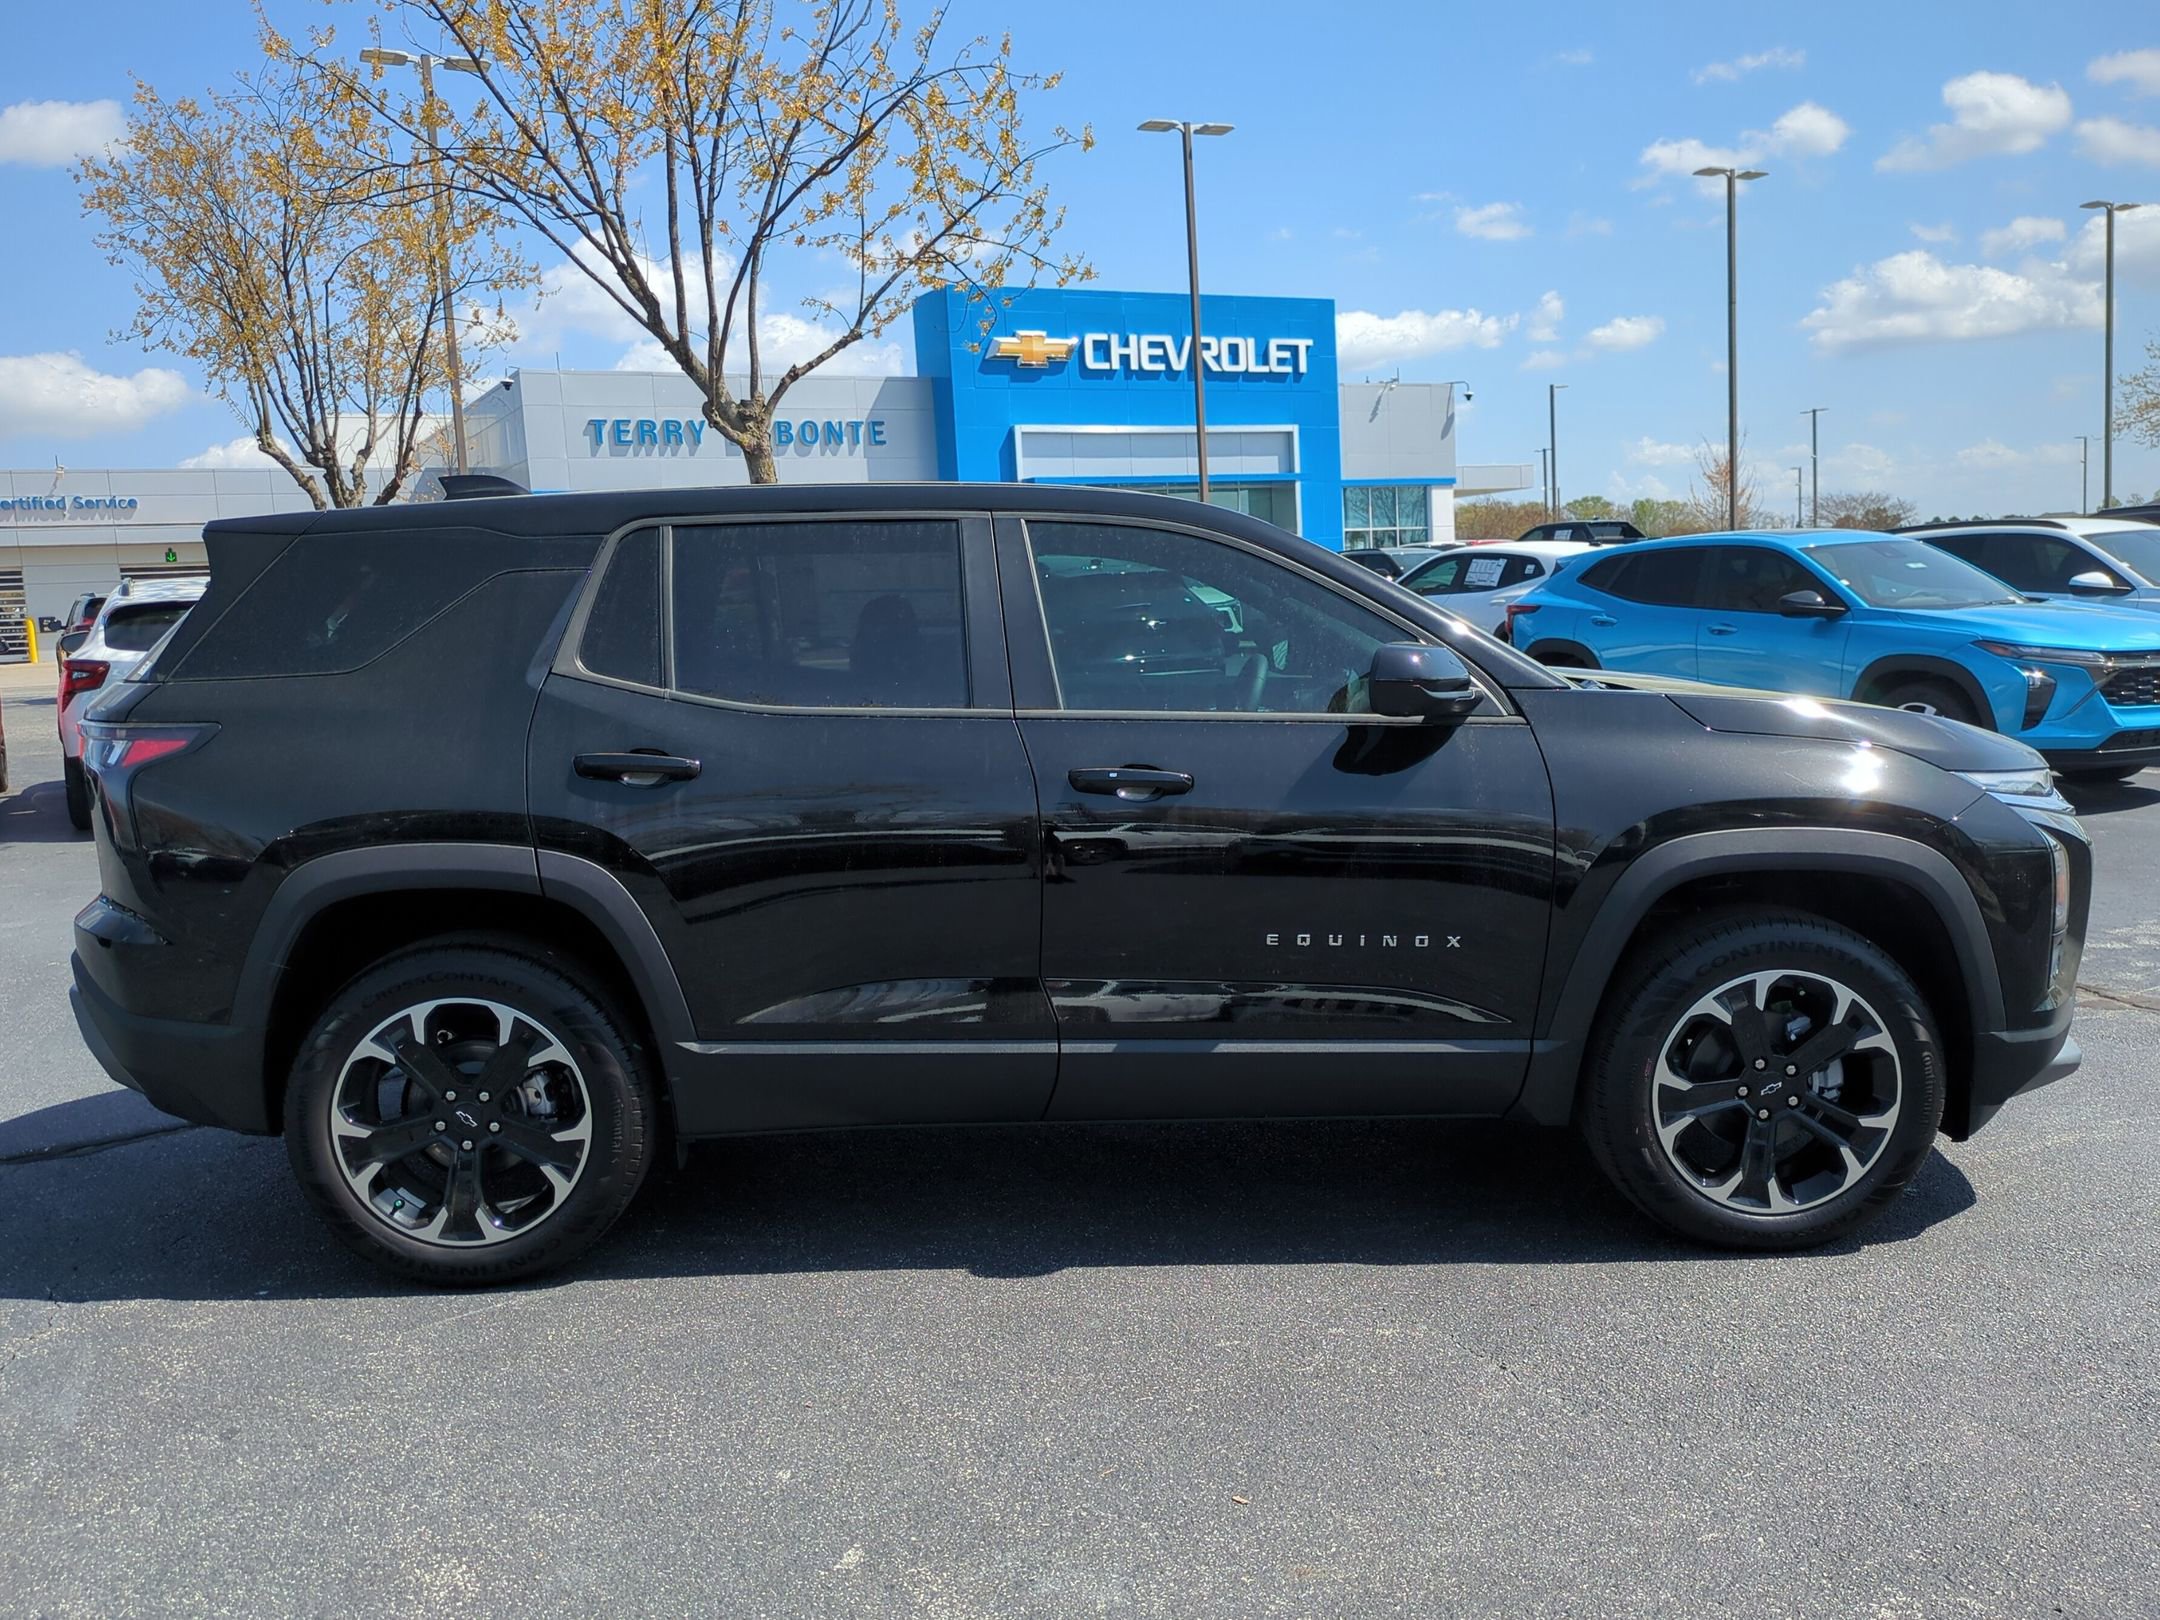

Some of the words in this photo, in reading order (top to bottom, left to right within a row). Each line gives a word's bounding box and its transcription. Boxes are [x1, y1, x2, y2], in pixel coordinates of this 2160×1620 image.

[1084, 333, 1313, 373] CHEVROLET
[588, 419, 706, 446] TERRY
[772, 420, 887, 447] BONTE
[0, 496, 66, 510] ertified
[72, 496, 138, 510] Service
[1266, 934, 1461, 948] EQUINOX
